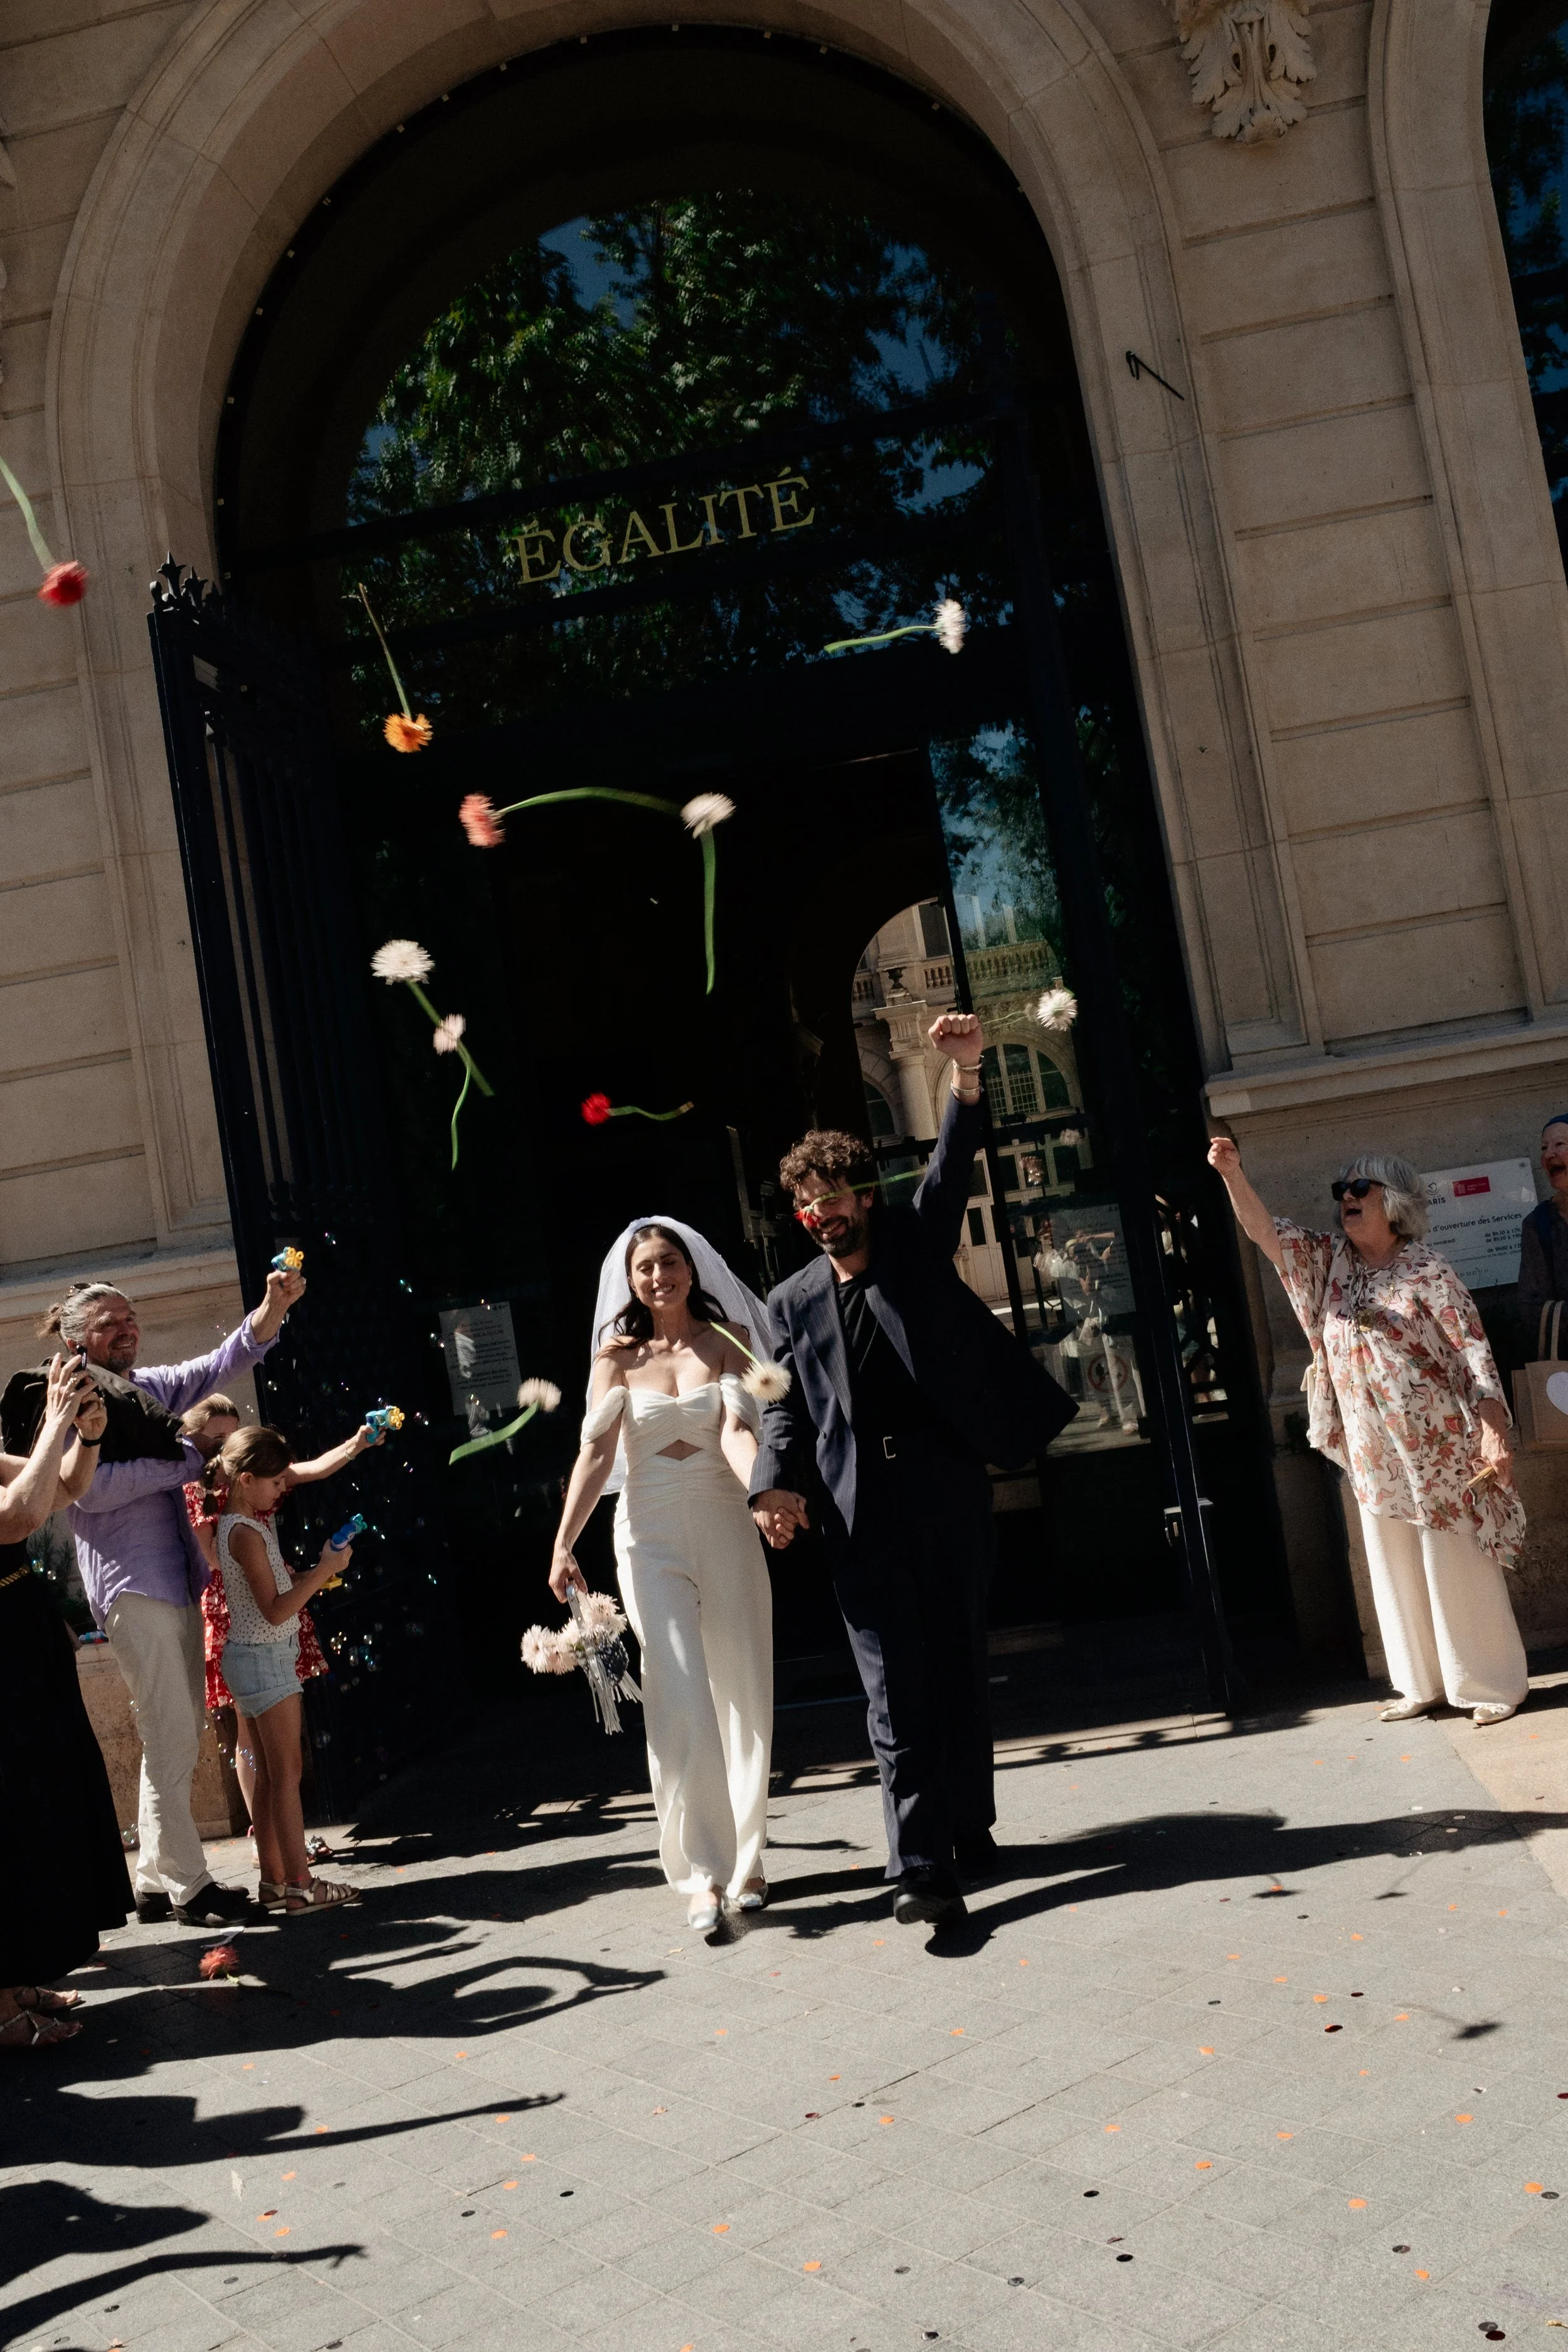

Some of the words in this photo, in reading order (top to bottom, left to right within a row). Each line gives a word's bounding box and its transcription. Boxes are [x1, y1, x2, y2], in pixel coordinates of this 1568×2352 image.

[512, 467, 815, 585] ÉGALITÉ
[1428, 1197, 1446, 1205] ARIS
[1433, 1220, 1475, 1232] d'ouverture
[1492, 1213, 1522, 1222] Services
